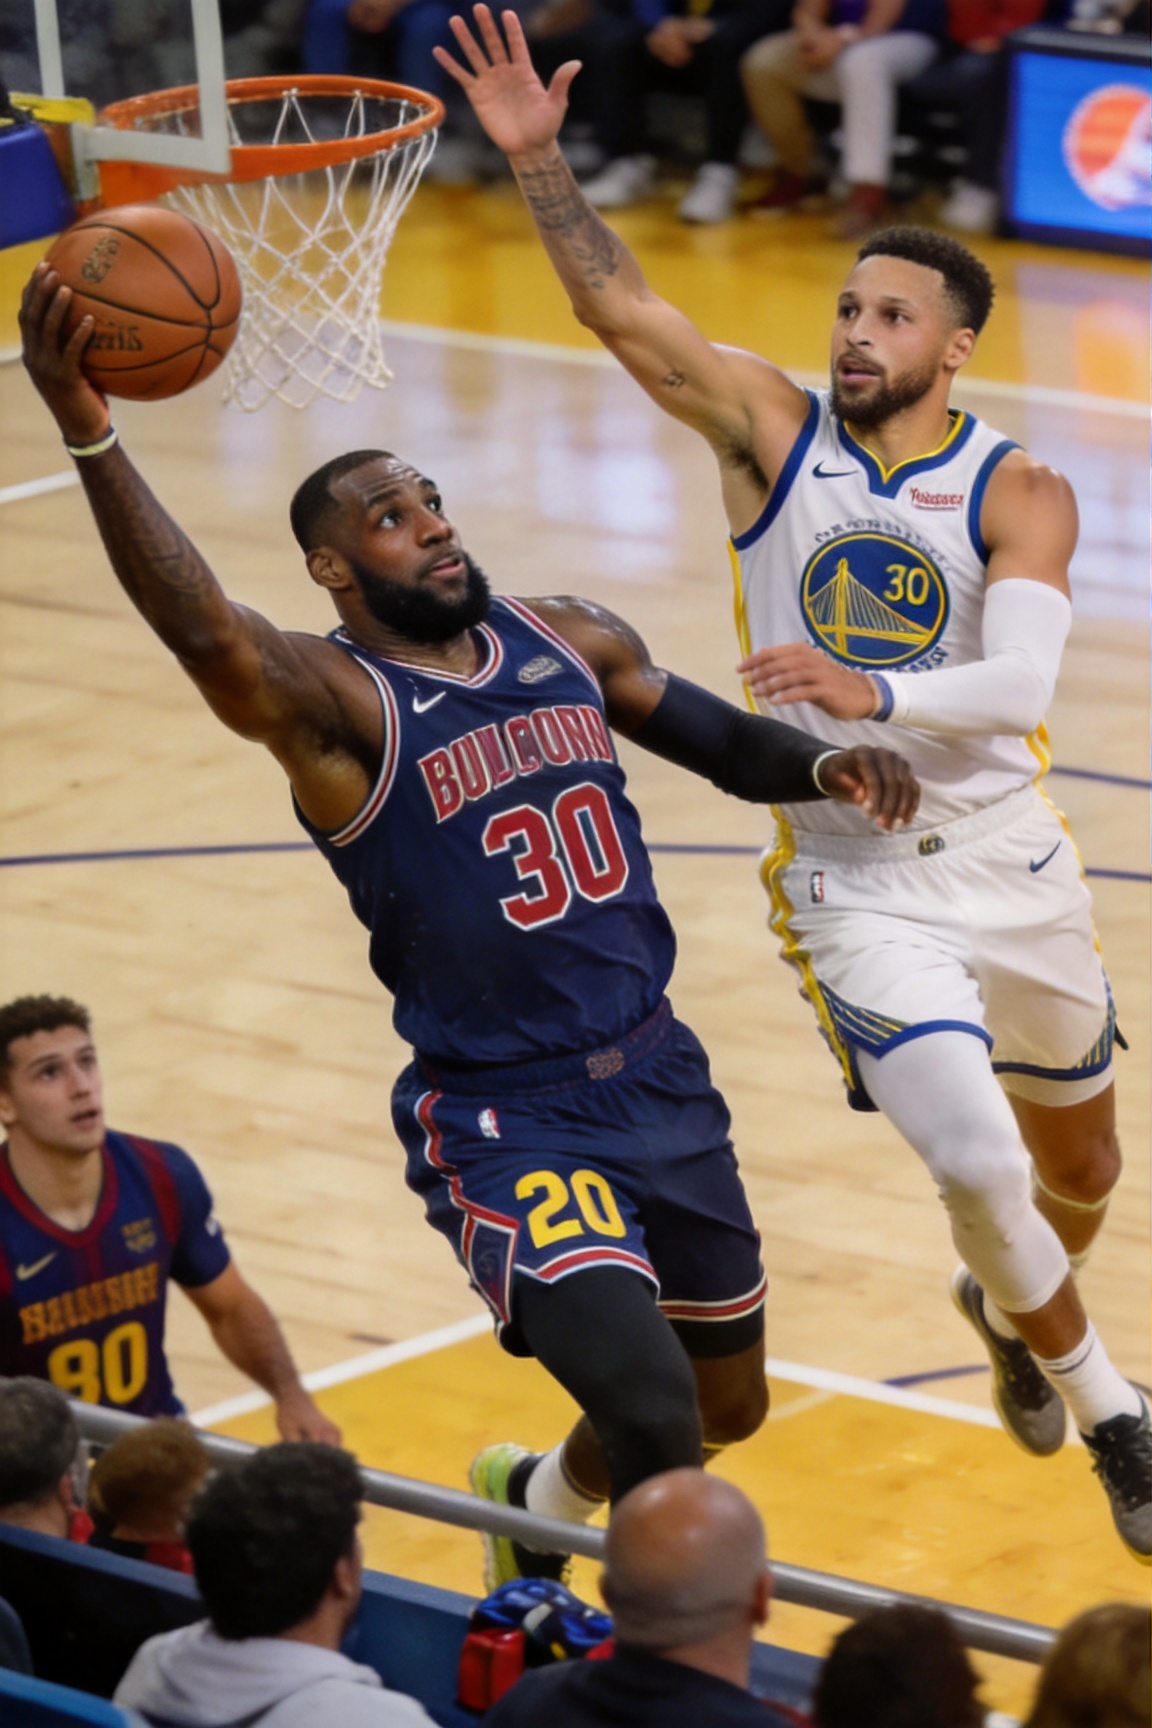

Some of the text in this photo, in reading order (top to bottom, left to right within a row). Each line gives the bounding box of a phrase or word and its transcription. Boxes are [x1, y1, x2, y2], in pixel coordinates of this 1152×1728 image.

[883, 563, 930, 606] 30
[481, 782, 629, 932] 30
[514, 1169, 627, 1249] 20
